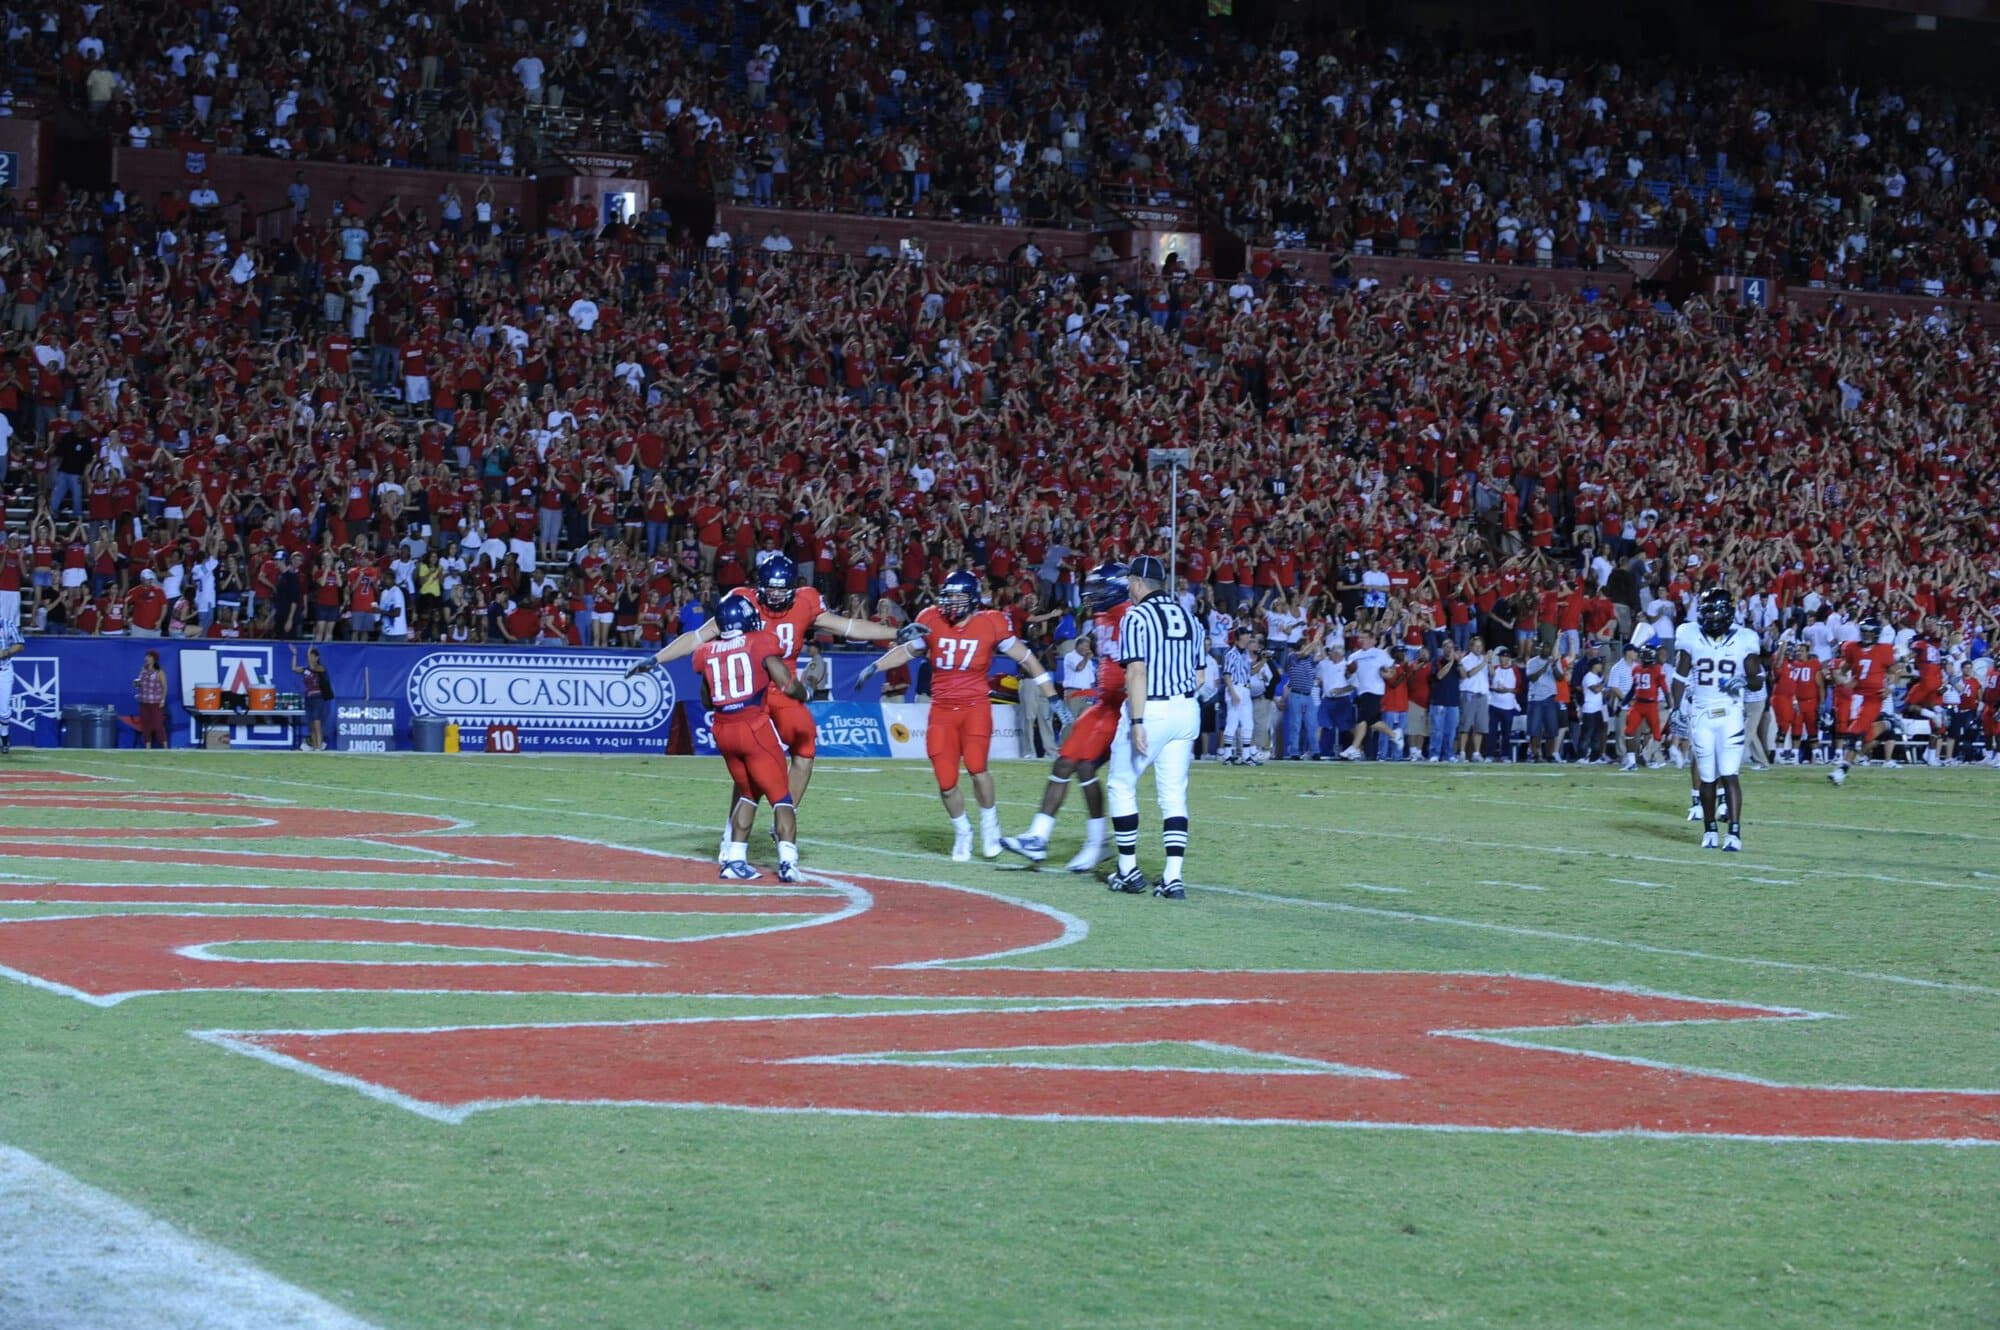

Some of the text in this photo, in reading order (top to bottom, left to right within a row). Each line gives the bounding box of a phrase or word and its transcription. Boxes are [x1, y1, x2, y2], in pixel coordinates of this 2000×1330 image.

[1747, 281, 1760, 298] 4
[1162, 605, 1188, 638] B
[936, 637, 979, 671] 37
[707, 652, 753, 703] 10
[1697, 658, 1737, 687] 29
[1858, 659, 1872, 680] 7
[436, 677, 648, 708] SOL CASINOS
[337, 706, 395, 720] PUSH-UPS
[830, 715, 878, 728] Tucson
[339, 723, 394, 737] WILBUR'S
[491, 730, 515, 751] 10
[815, 722, 883, 746] tizen
[347, 740, 386, 752] COUNT
[517, 736, 539, 745] THE
[545, 736, 591, 745] PASCUA
[596, 737, 632, 747] YAQUI
